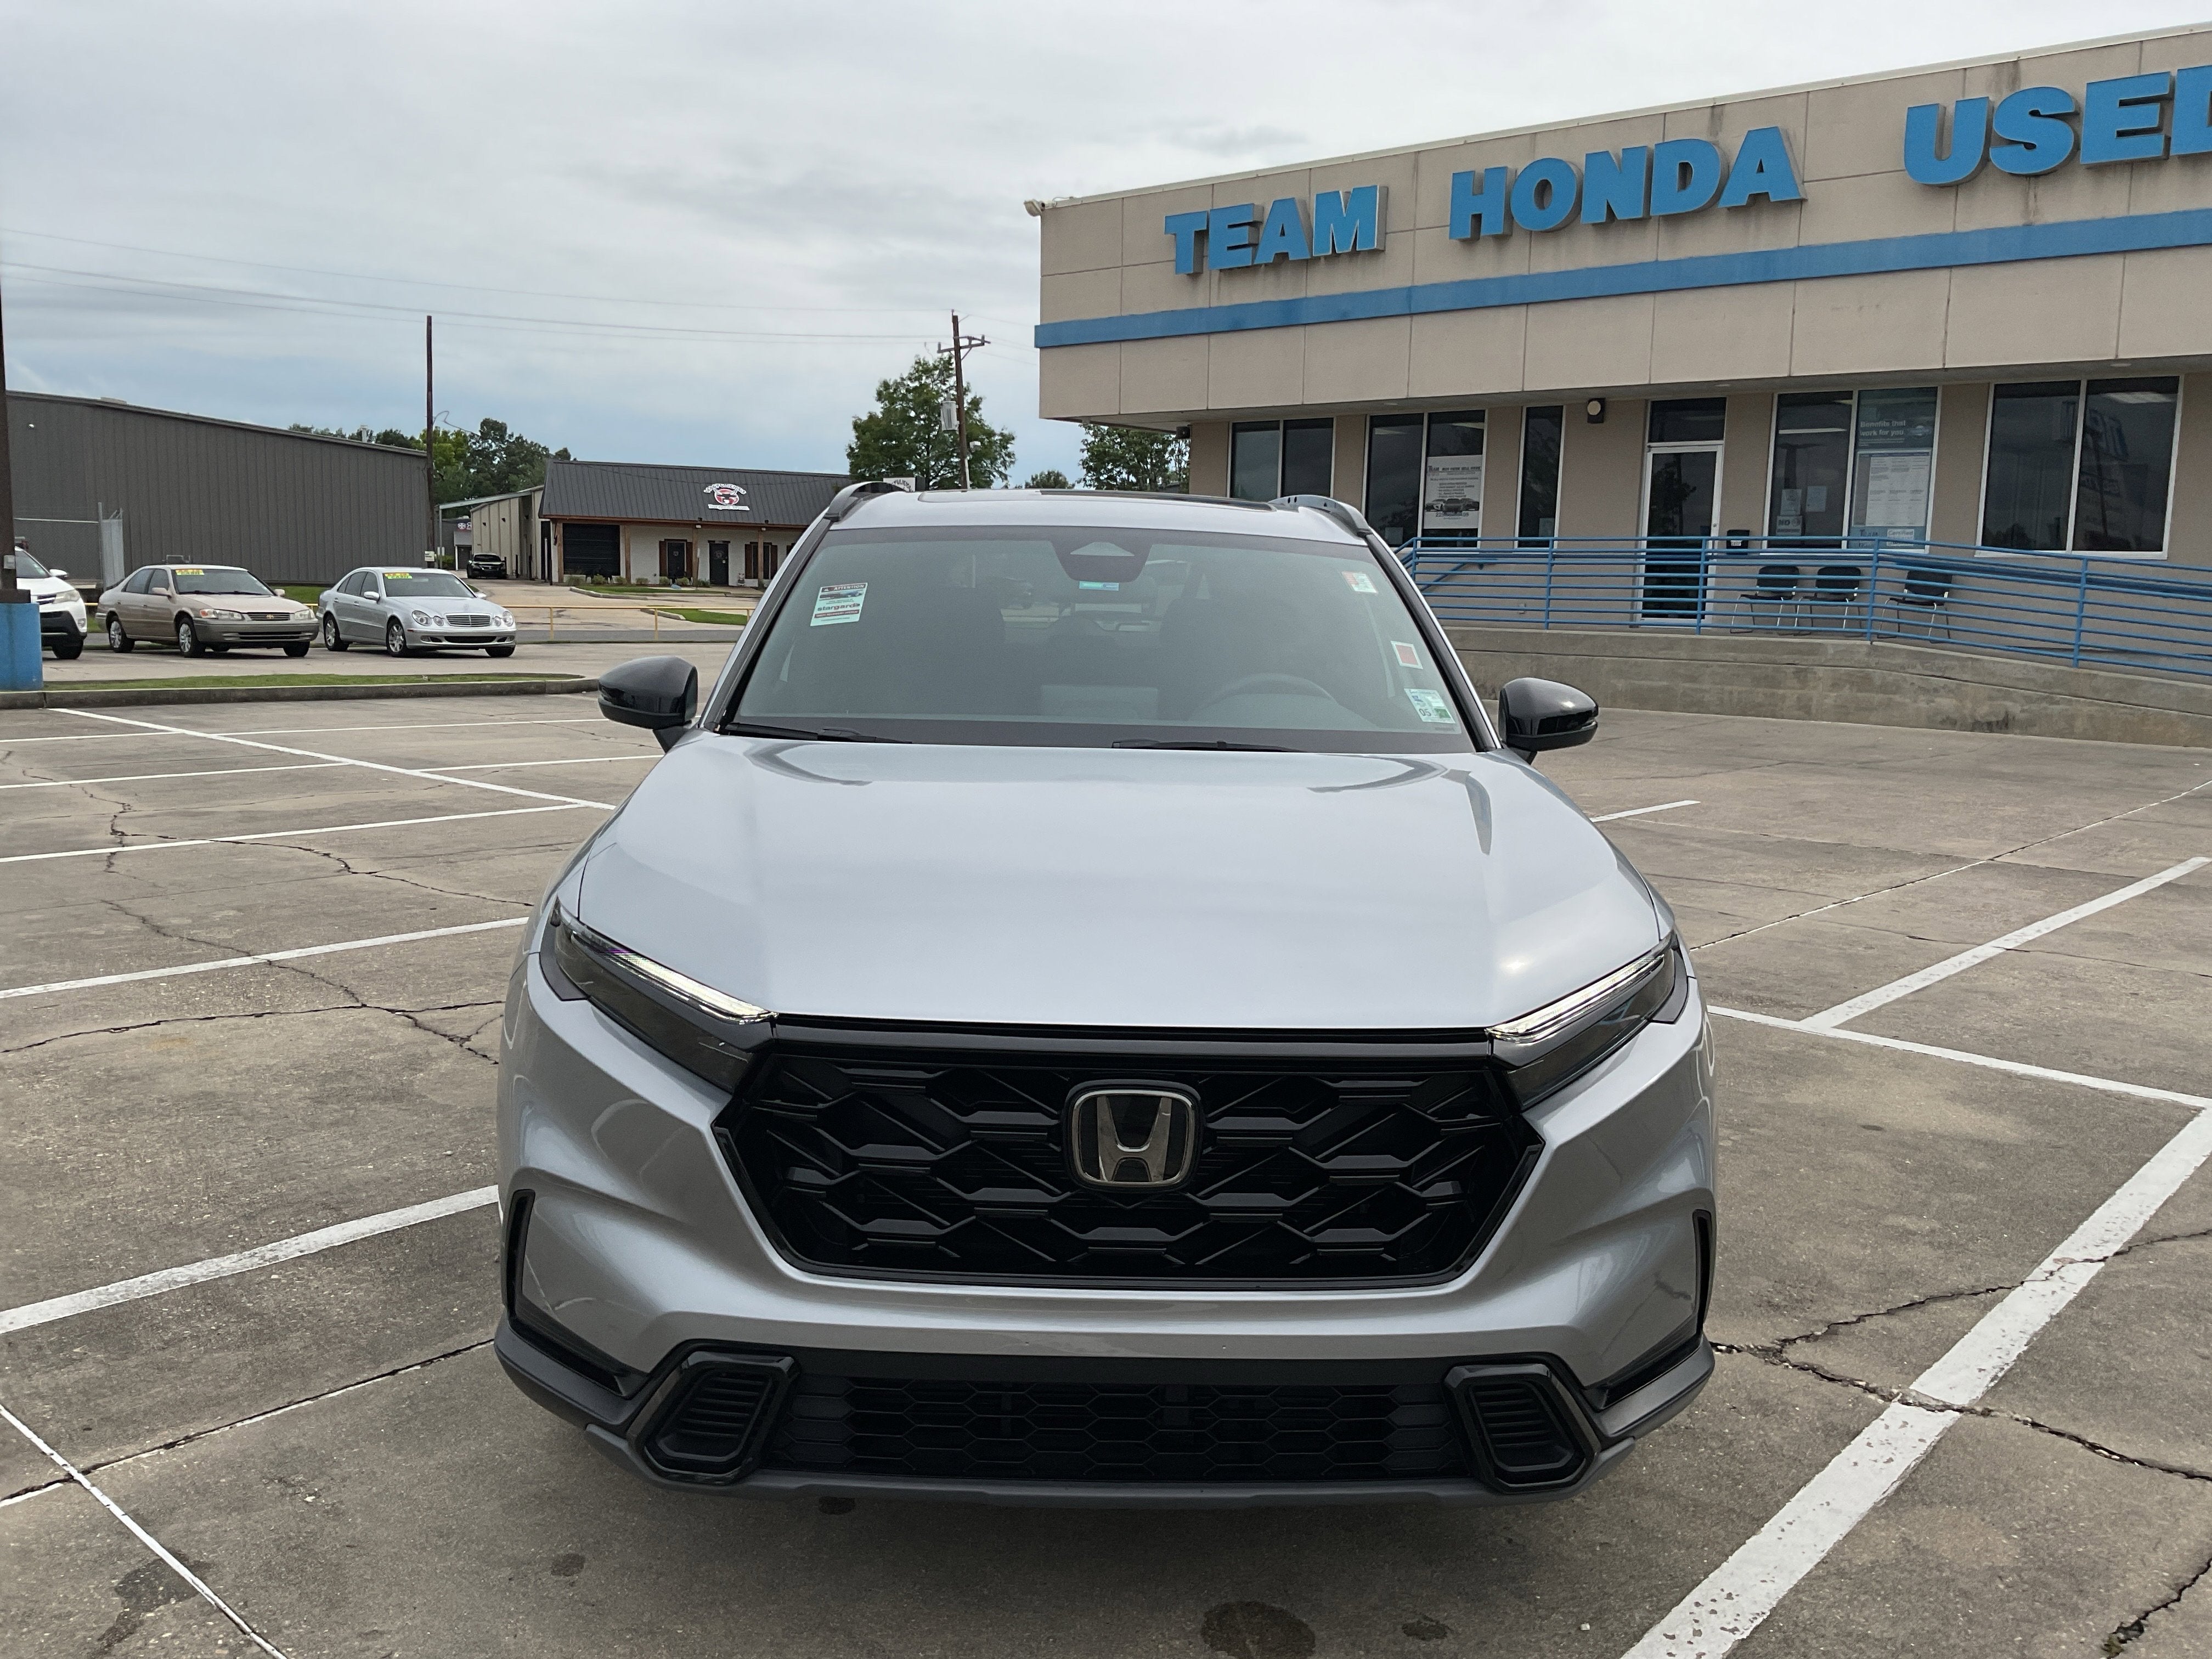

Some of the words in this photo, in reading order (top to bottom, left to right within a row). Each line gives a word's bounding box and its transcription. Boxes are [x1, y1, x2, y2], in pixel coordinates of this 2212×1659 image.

[1164, 185, 1387, 275] TEAM
[1448, 126, 1807, 241] HONDA
[1419, 708, 1431, 716] 05
